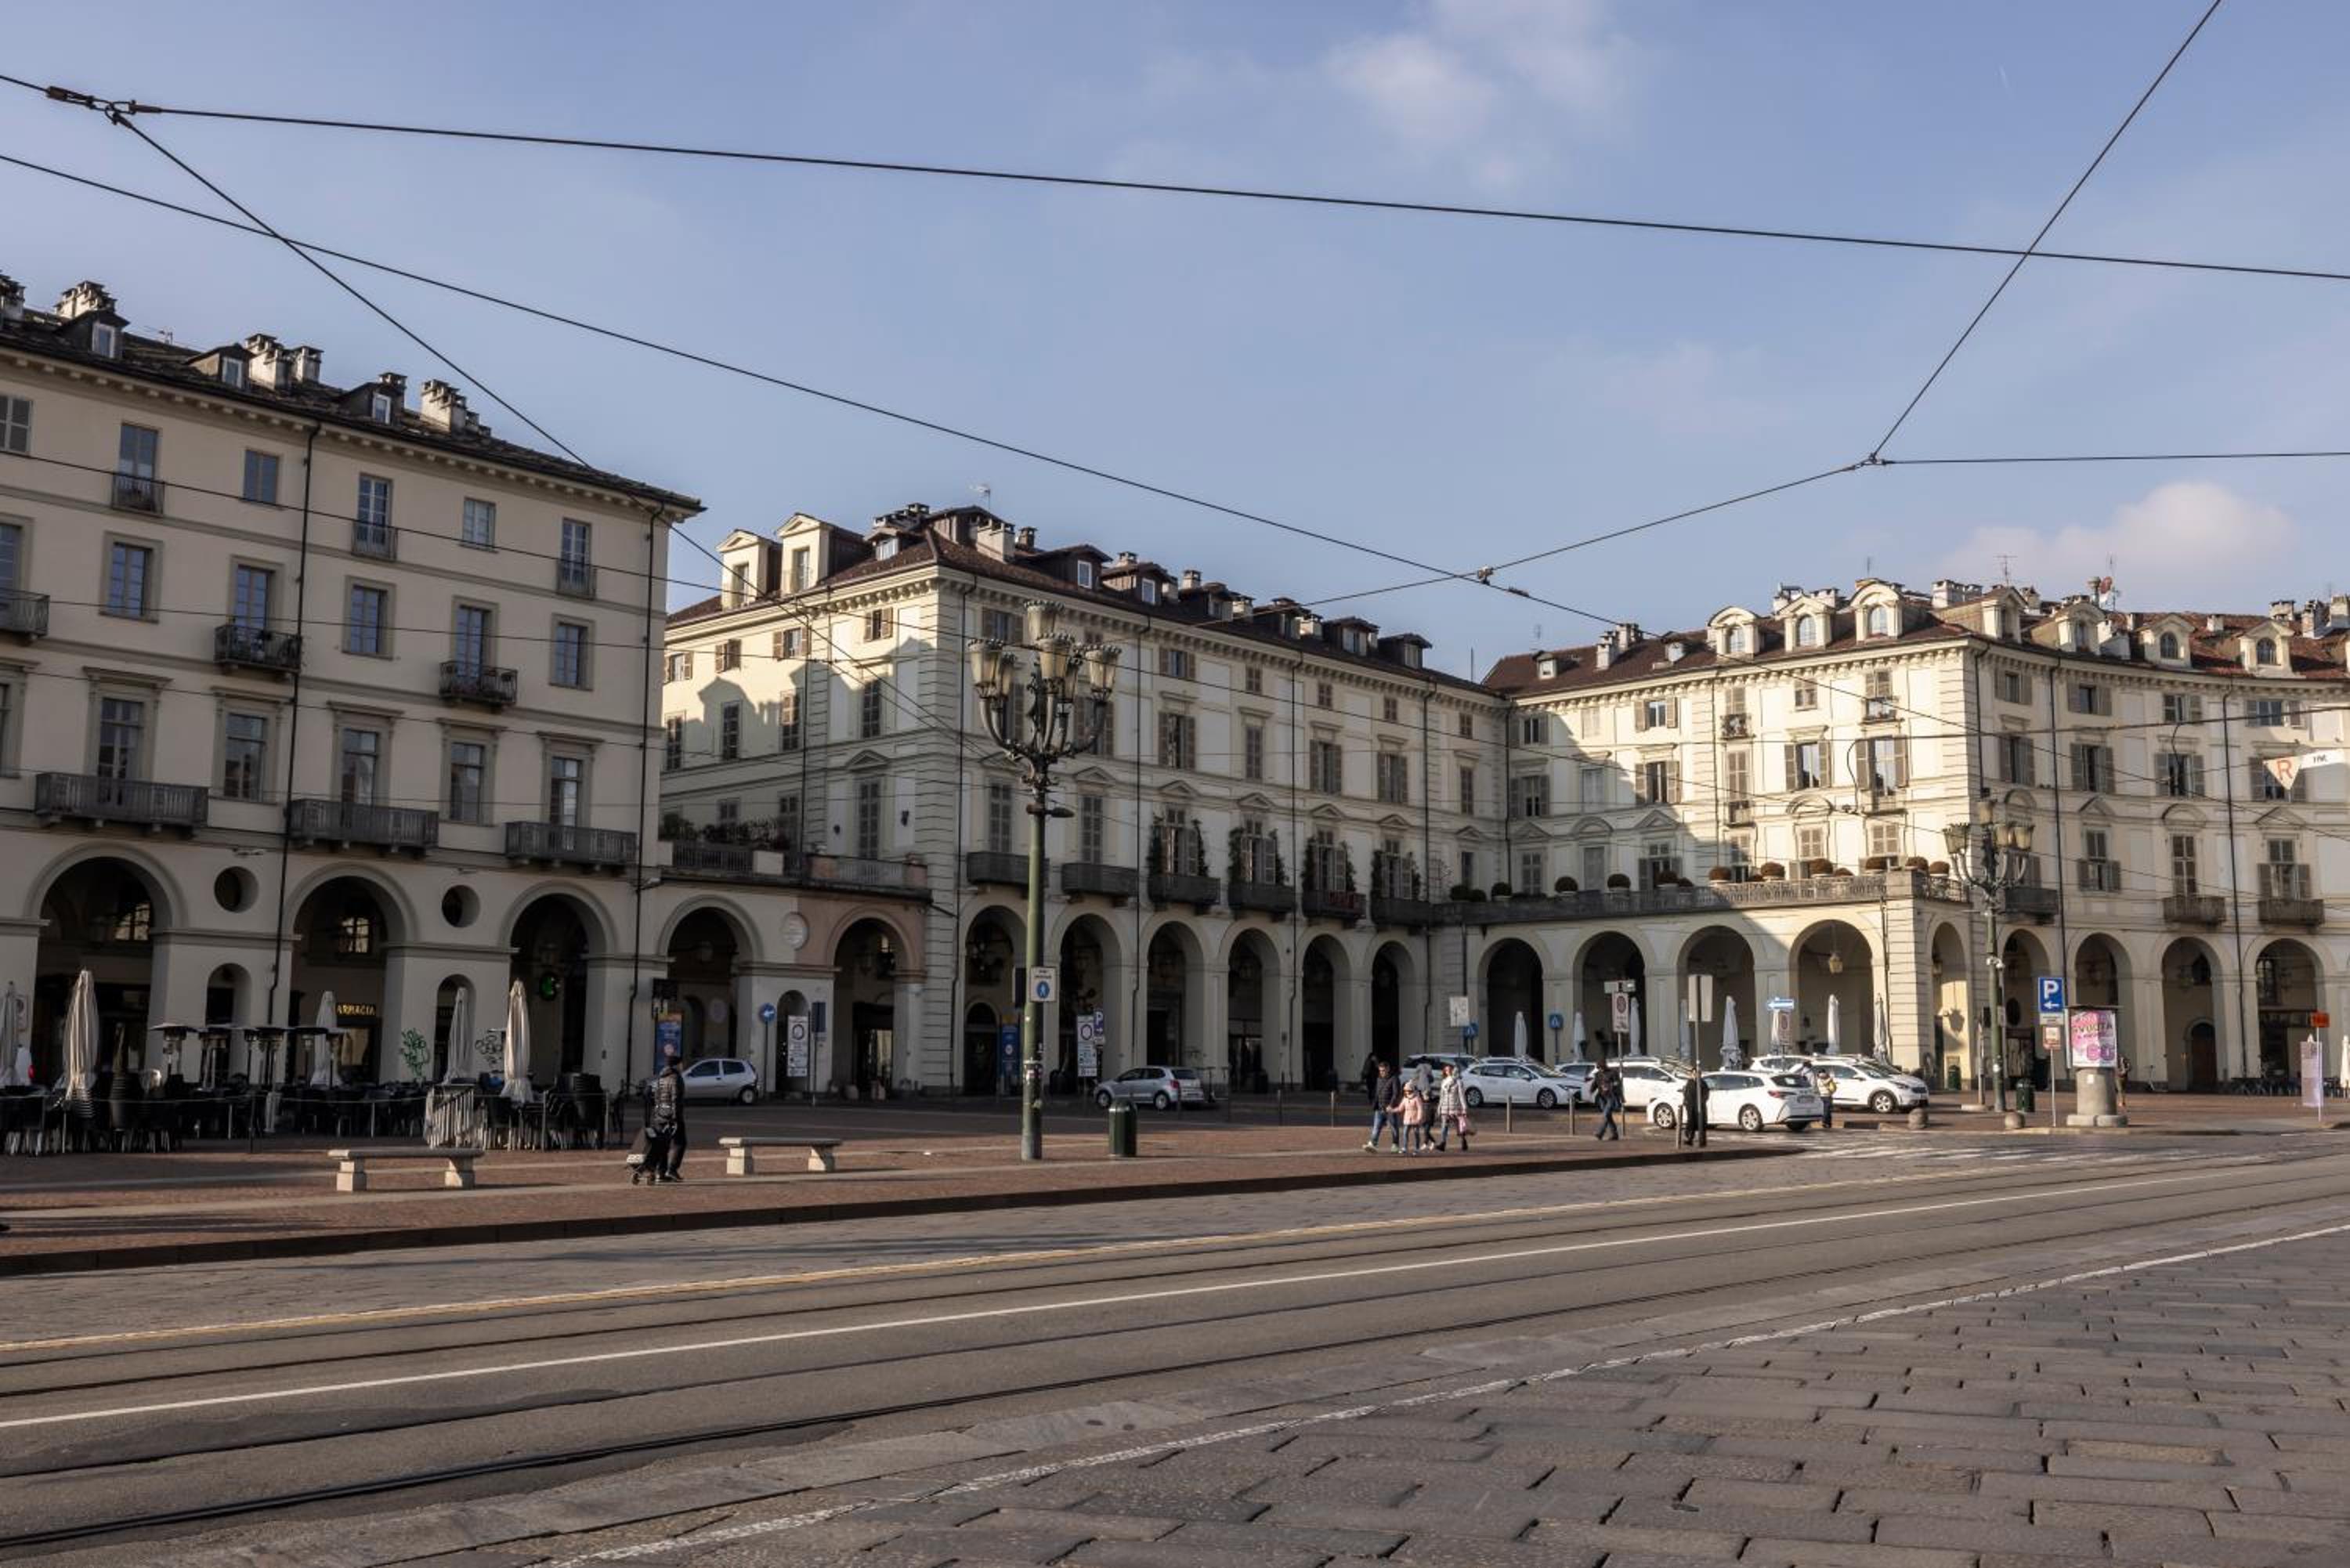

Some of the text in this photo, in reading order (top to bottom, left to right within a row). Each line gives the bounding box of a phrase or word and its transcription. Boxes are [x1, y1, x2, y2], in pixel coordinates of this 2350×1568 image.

[2276, 759, 2293, 780] R
[2043, 980, 2059, 1000] P
[338, 1005, 375, 1016] ARMACIA
[1095, 1010, 1104, 1026] P
